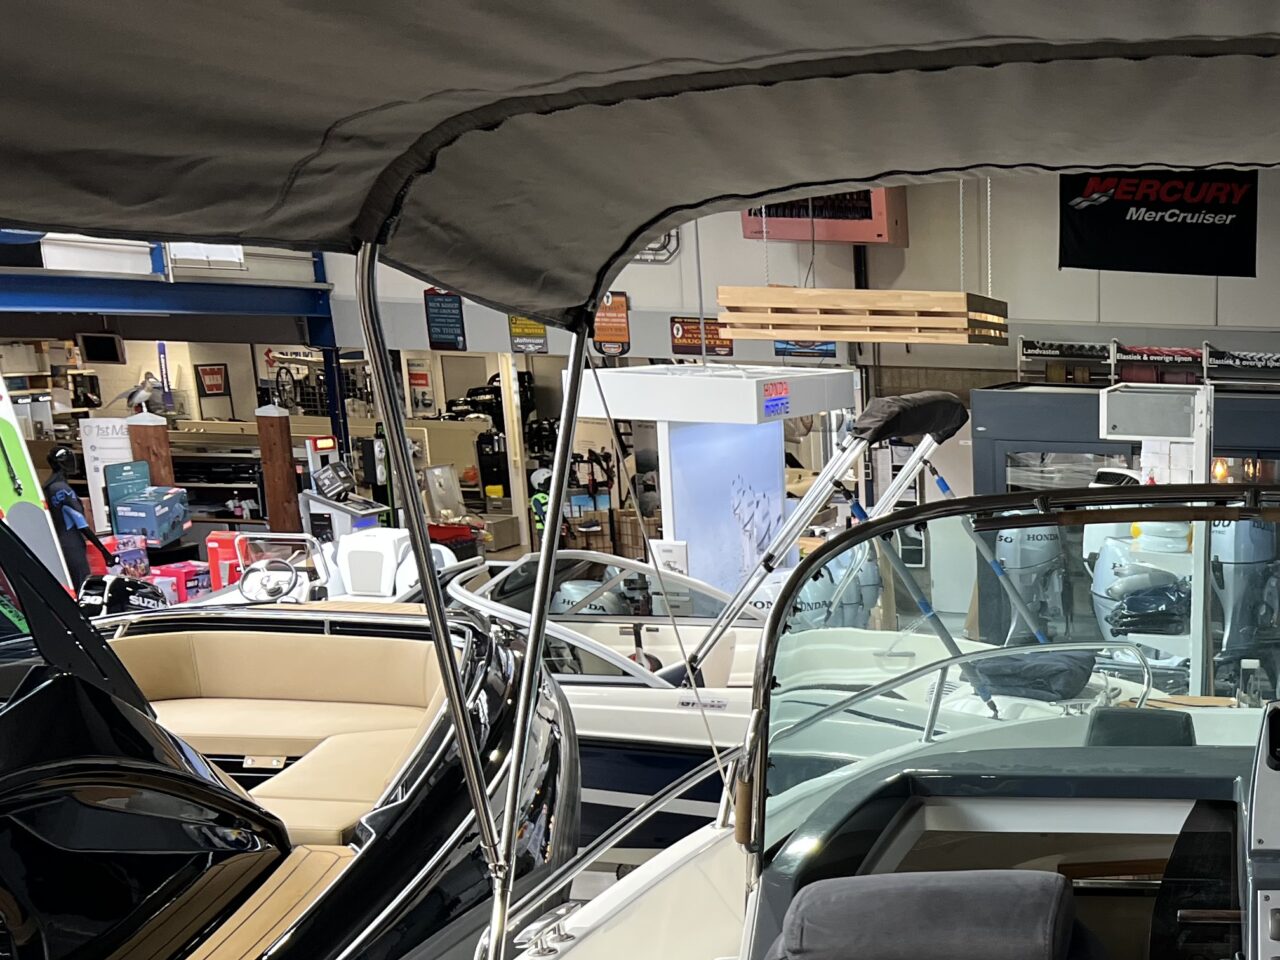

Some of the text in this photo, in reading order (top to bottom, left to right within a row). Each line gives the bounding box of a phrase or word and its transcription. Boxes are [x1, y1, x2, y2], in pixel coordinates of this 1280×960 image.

[1082, 177, 1250, 204] MERCURY
[1125, 207, 1237, 224] MerCruiser
[1023, 347, 1060, 355] Landvasten
[1149, 354, 1173, 362] overige
[1175, 355, 1192, 363] lijnen
[1242, 359, 1265, 367] overige
[764, 382, 789, 397] HONDA
[764, 401, 789, 416] MARINE
[111, 424, 129, 436] Ma
[1027, 533, 1059, 541] HONDA
[129, 595, 168, 609] SUZU
[561, 598, 606, 612] HODA
[800, 600, 833, 612] ONDA
